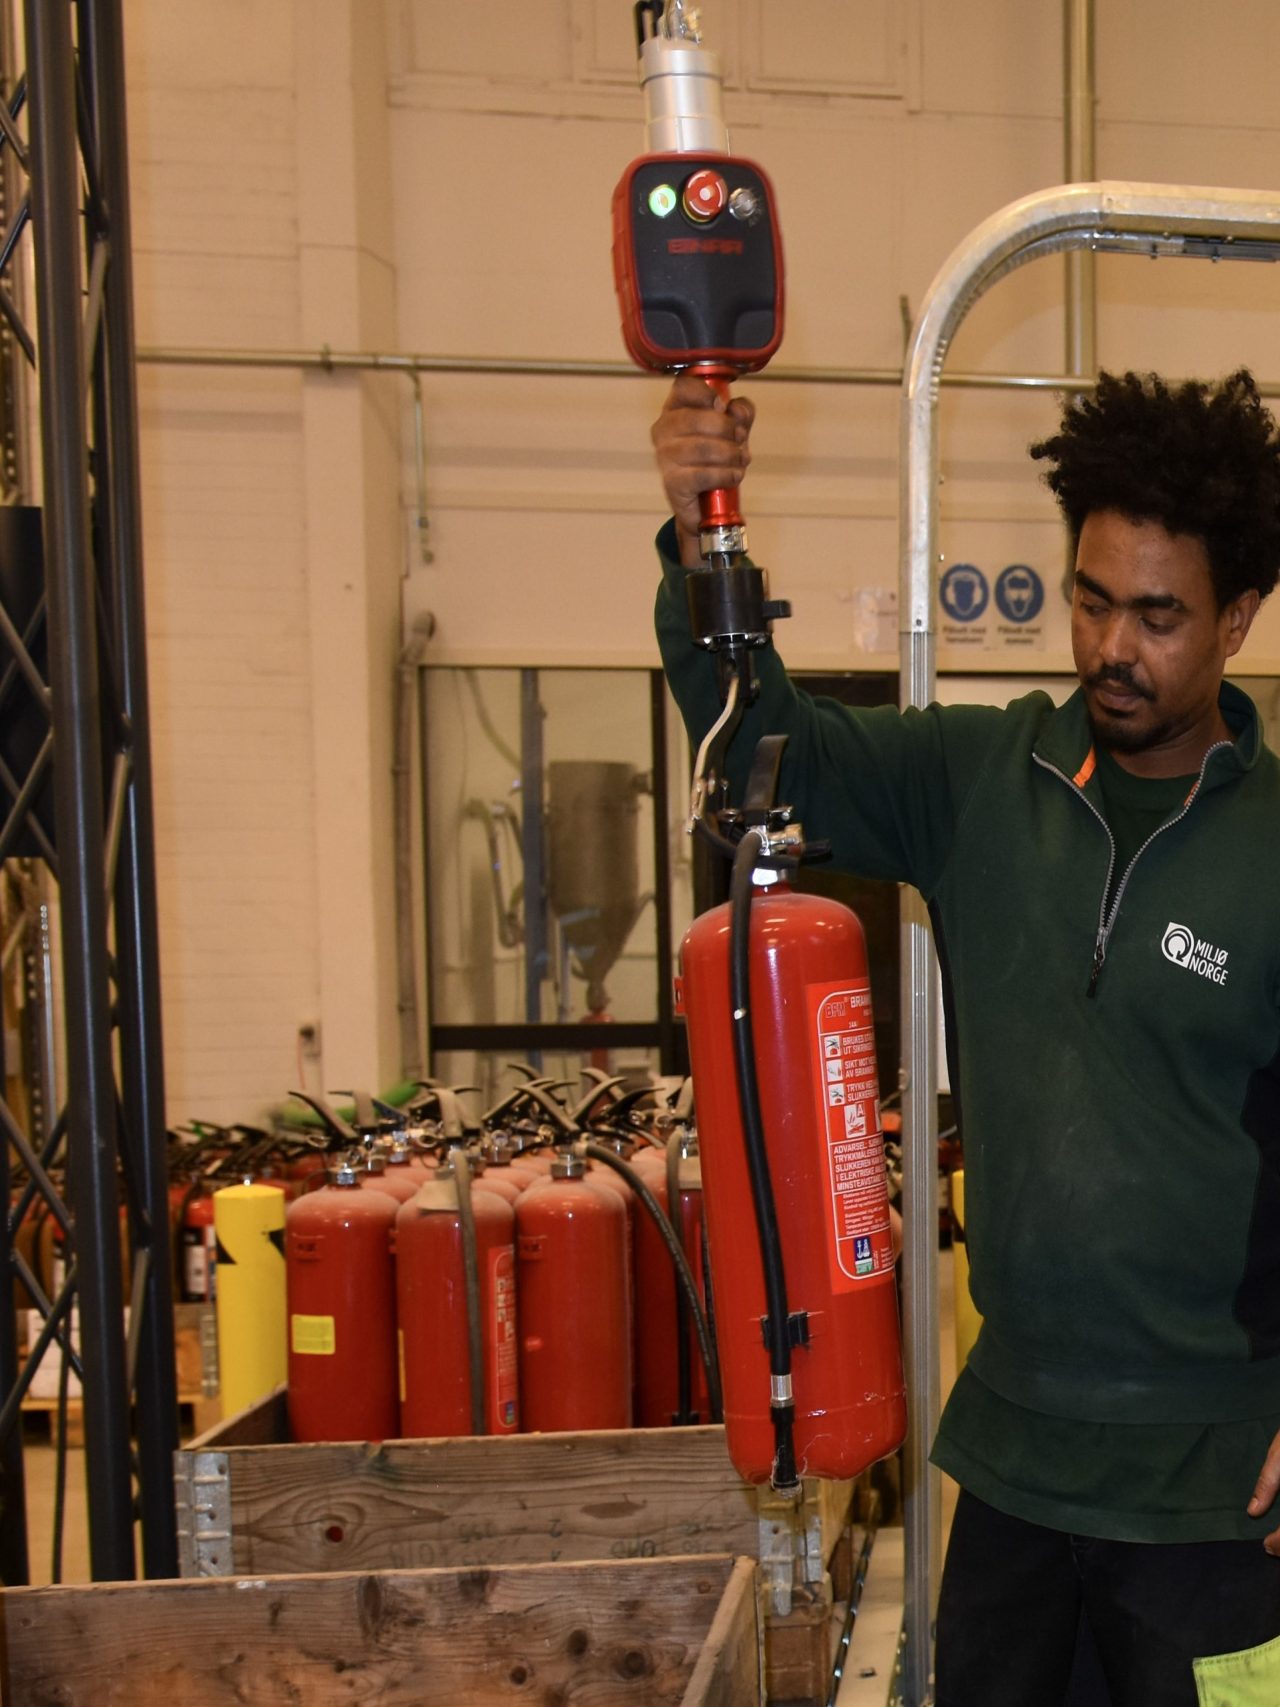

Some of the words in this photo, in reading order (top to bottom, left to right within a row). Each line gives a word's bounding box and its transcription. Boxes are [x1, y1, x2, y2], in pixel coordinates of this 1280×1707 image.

[1194, 939, 1229, 966] MILJØ
[1188, 955, 1229, 986] NORGE
[843, 1046, 852, 1055] UT
[845, 1068, 854, 1079] AV
[857, 1102, 865, 1117] A
